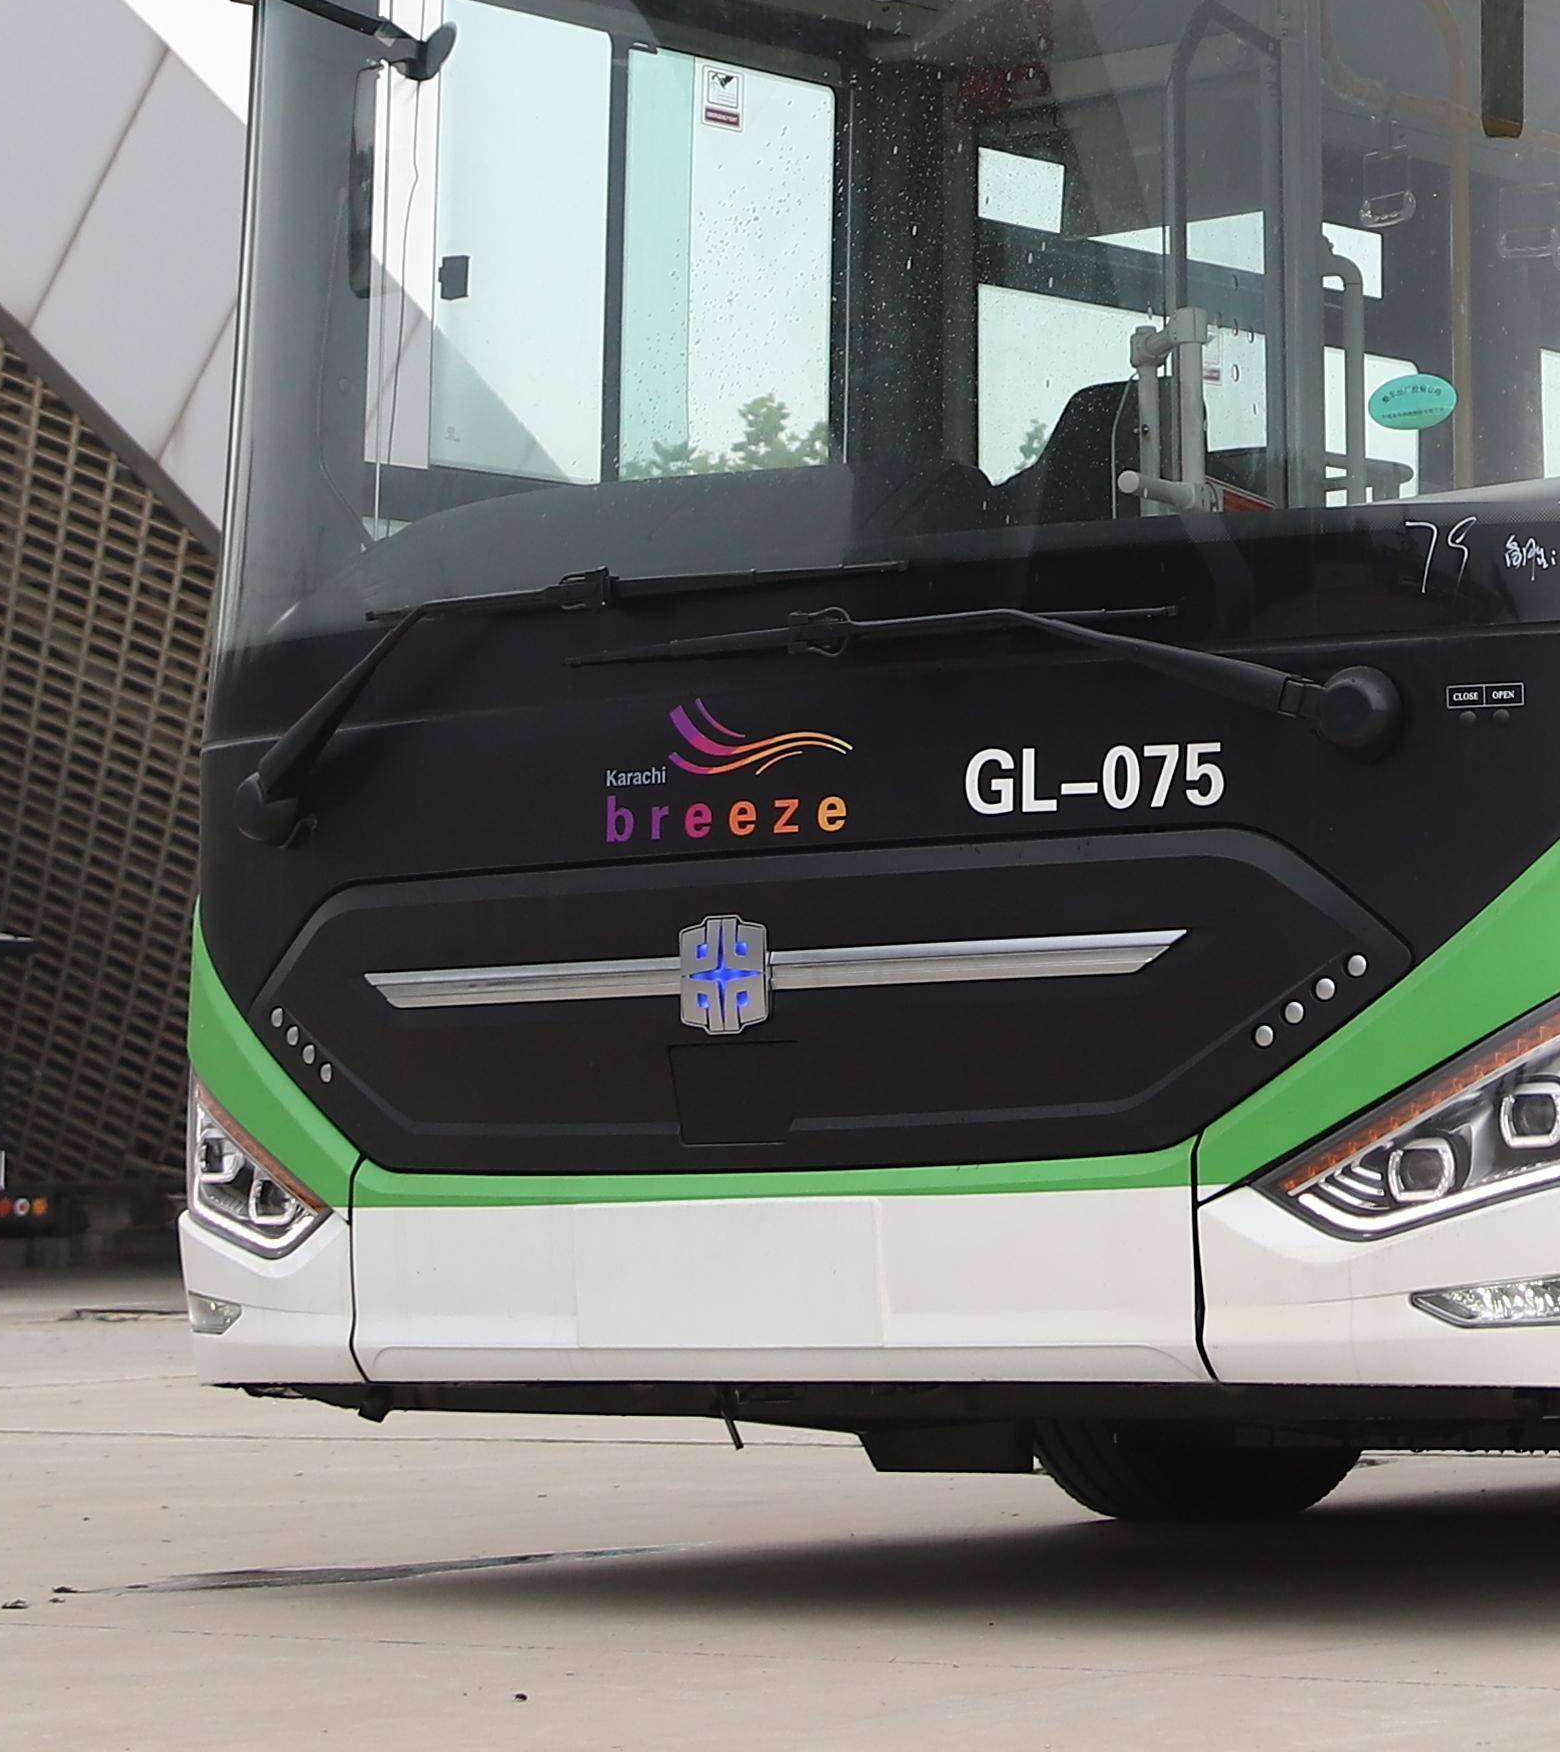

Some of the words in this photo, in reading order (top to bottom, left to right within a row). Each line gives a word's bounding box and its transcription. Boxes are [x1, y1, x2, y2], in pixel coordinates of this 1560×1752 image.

[1452, 691, 1479, 702] CLOSE
[1491, 689, 1515, 700] OPEN
[605, 764, 667, 787] Karachi
[964, 741, 1226, 815] GL-075
[605, 793, 849, 843] breeze
